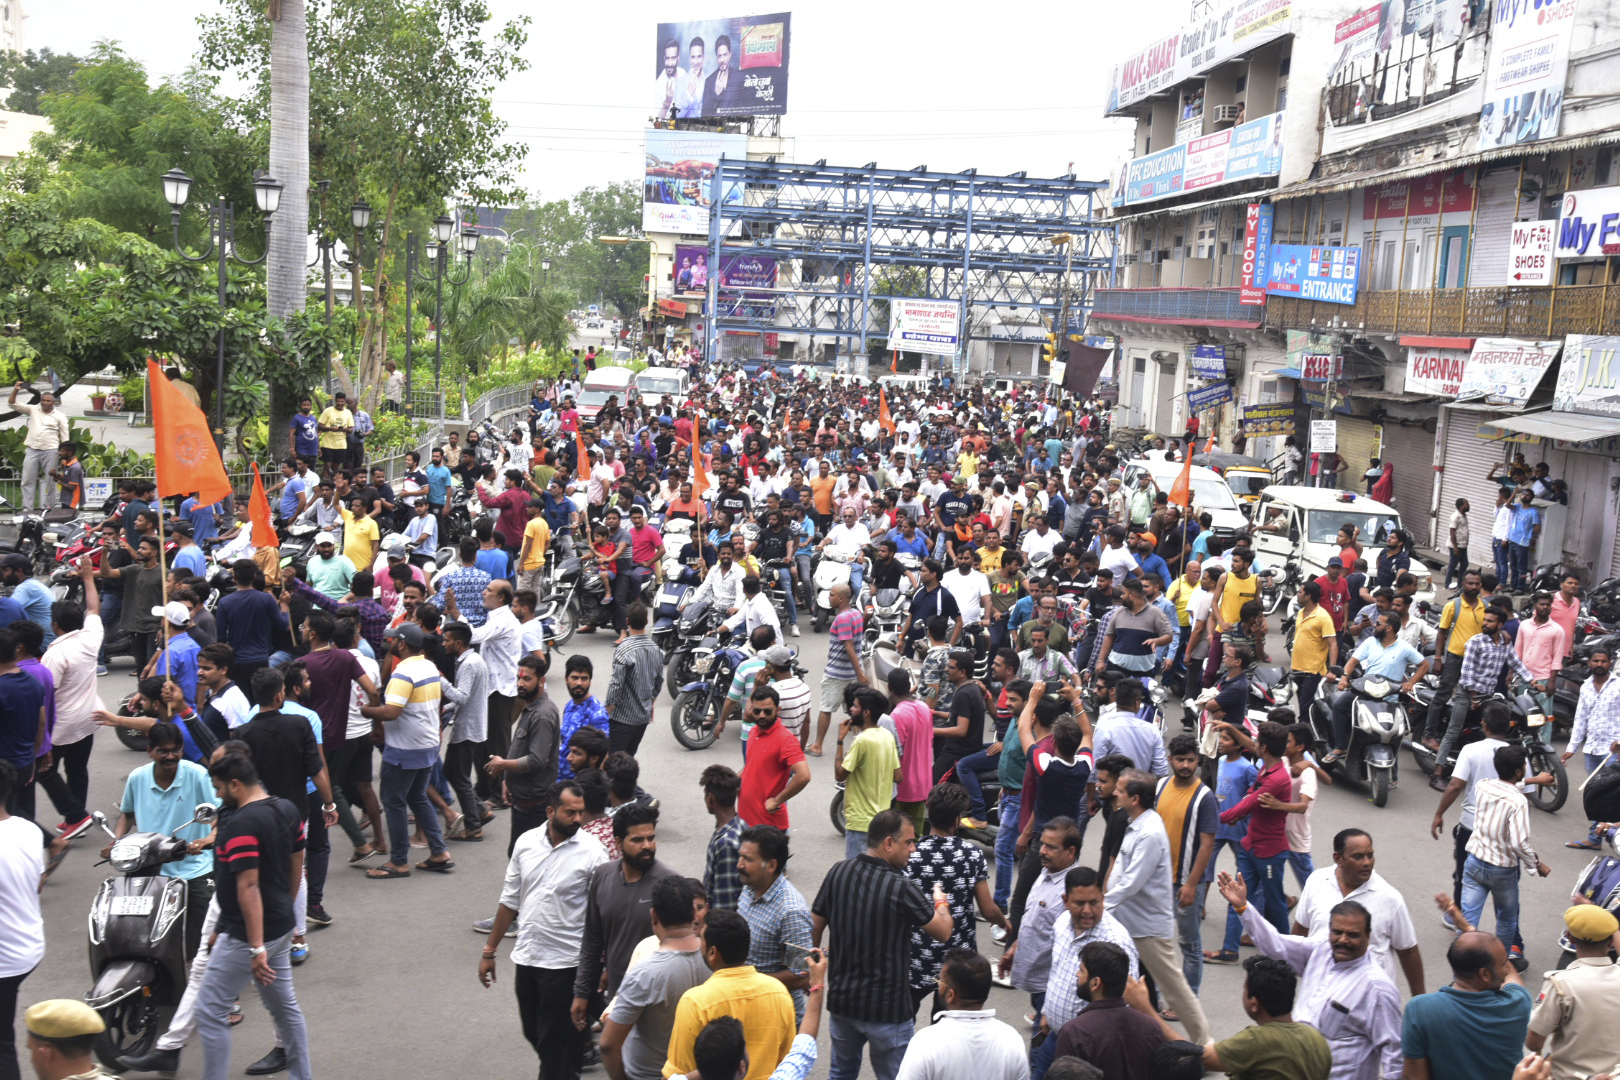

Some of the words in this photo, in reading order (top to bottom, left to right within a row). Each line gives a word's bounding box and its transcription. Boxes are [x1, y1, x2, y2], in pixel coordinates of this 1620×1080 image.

[1272, 9, 1289, 21] HOSTEL
[1546, 1, 1575, 24] SHOES
[1180, 28, 1200, 58] Grade
[1209, 24, 1218, 43] to
[1506, 49, 1533, 66] COMPLETE
[1533, 43, 1555, 58] FAMILY
[1500, 66, 1529, 83] FOOTWEAR
[1528, 60, 1551, 75] SHOPEE
[1209, 132, 1229, 148] COURSES
[1130, 162, 1144, 183] PFC
[1143, 150, 1184, 181] EDUCATION
[1156, 179, 1171, 195] Think
[1388, 198, 1407, 210] Dealer
[1513, 227, 1529, 249] My
[1559, 216, 1598, 255] My
[1598, 213, 1620, 248] F
[1256, 218, 1269, 285] ENTRANCE
[1515, 255, 1546, 269] SHOES
[1273, 261, 1284, 281] My
[1241, 289, 1262, 297] Shoes
[1301, 279, 1354, 302] ENTRANCE
[1577, 347, 1617, 396] J.K.
